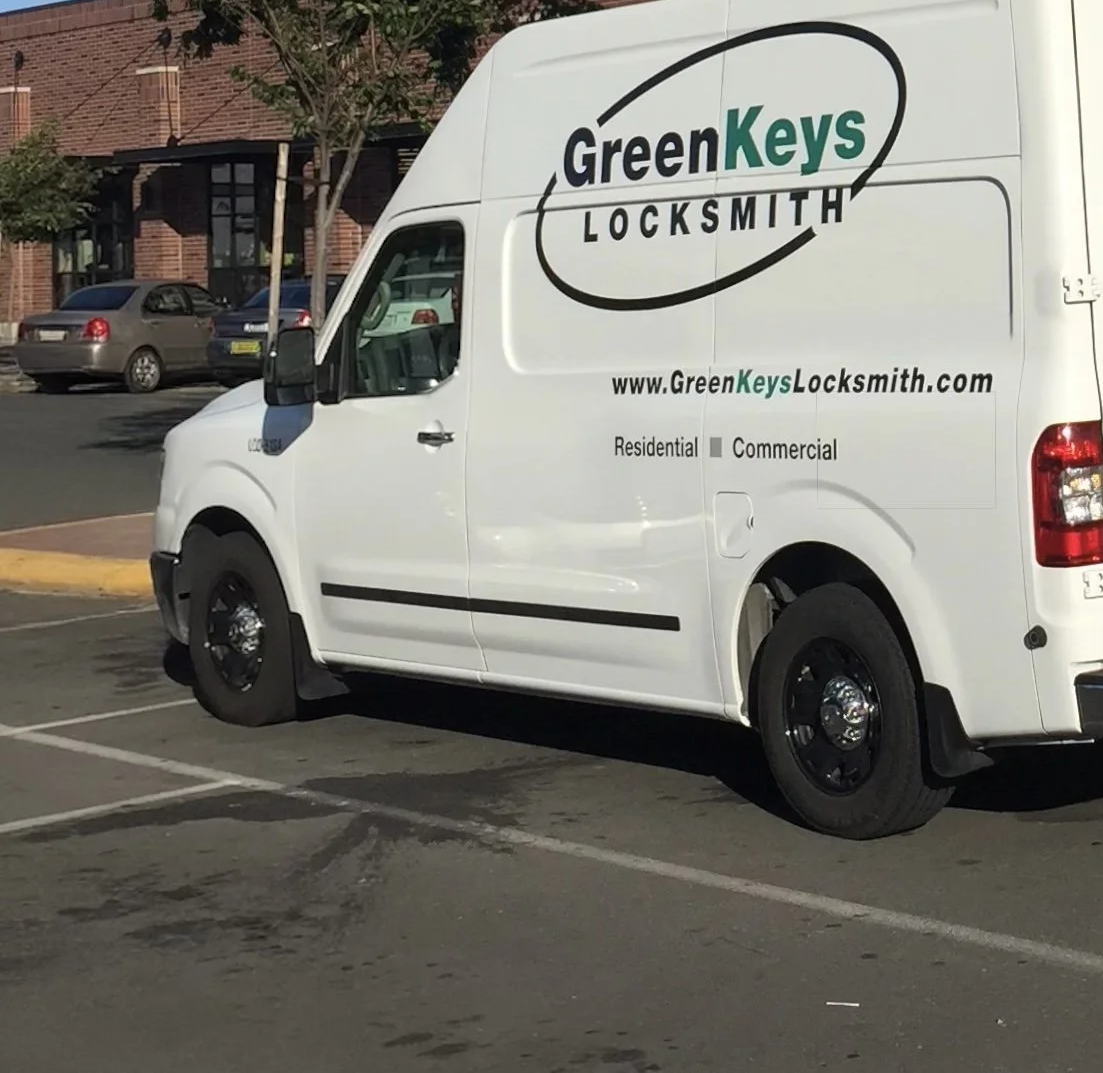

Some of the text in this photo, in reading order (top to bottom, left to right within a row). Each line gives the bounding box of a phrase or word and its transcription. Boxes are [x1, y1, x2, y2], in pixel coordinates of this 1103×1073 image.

[563, 104, 866, 188] GreenKeys
[583, 187, 843, 243] LOCKSMITH
[611, 367, 994, 399] www.GreenKeysLocksmith.com
[614, 436, 838, 461] Residential Commercial
